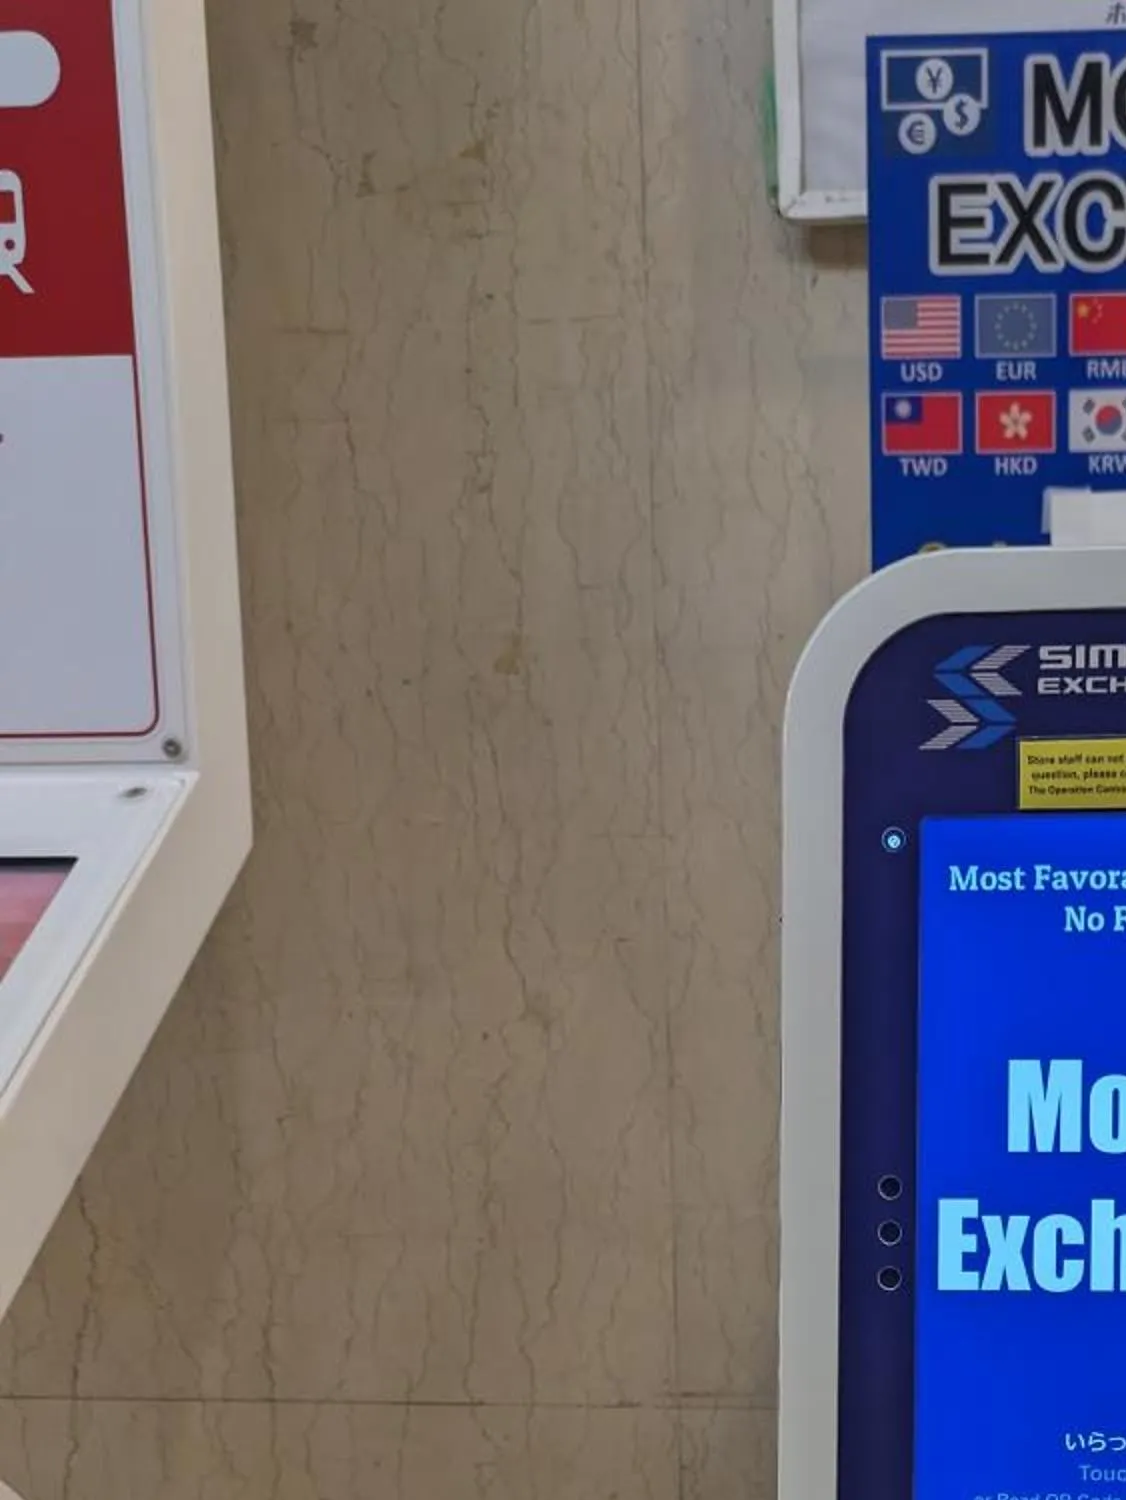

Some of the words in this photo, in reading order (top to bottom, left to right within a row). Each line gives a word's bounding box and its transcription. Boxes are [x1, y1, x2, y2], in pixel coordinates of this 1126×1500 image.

[901, 362, 942, 382] USD
[996, 361, 1036, 380] EUR
[899, 458, 947, 476] TWD
[995, 456, 1037, 474] HKD
[1027, 755, 1055, 765] Store
[1058, 752, 1082, 764] staff
[1085, 755, 1105, 764] can
[1107, 754, 1124, 763] not
[949, 865, 1026, 891] Most
[1063, 905, 1105, 932] No
